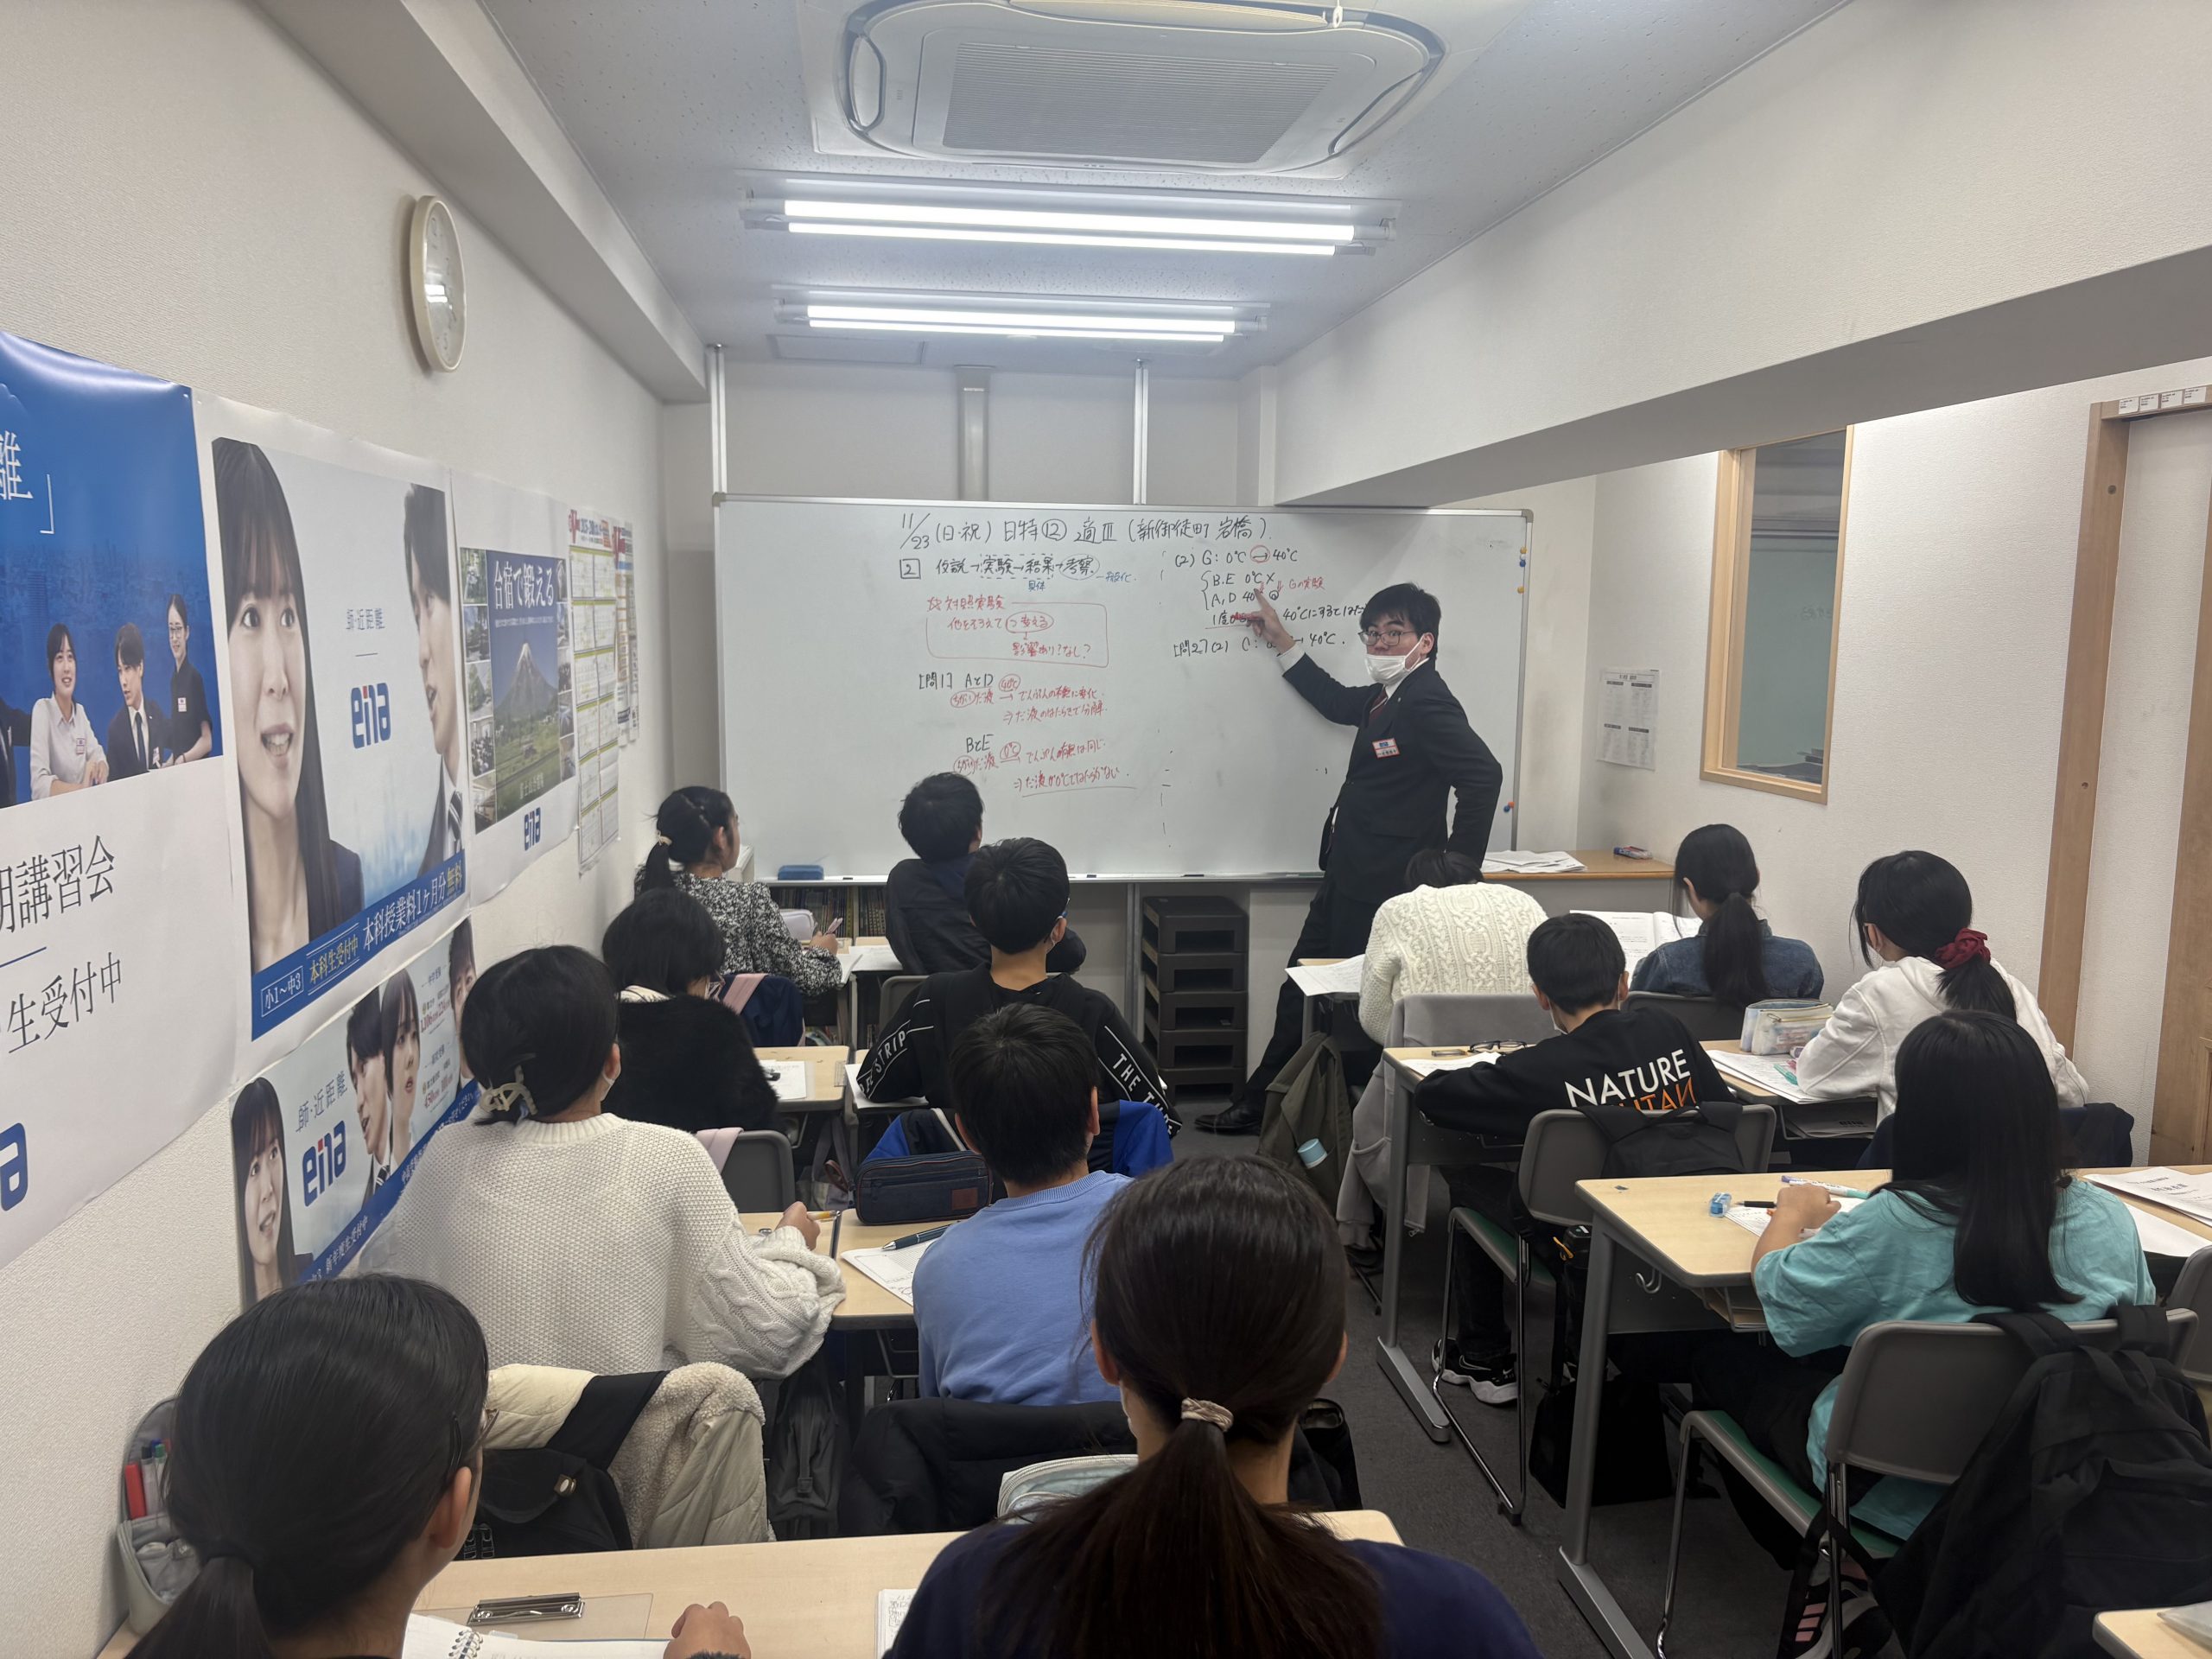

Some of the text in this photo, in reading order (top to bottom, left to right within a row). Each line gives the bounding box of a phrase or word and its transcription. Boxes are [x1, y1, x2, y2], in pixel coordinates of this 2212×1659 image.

[493, 561, 554, 609] 合宿で鍛える
[351, 683, 391, 749] ena
[1112, 1052, 1141, 1092] THE
[1564, 1048, 1691, 1108] NATURE
[302, 1120, 346, 1207] ena
